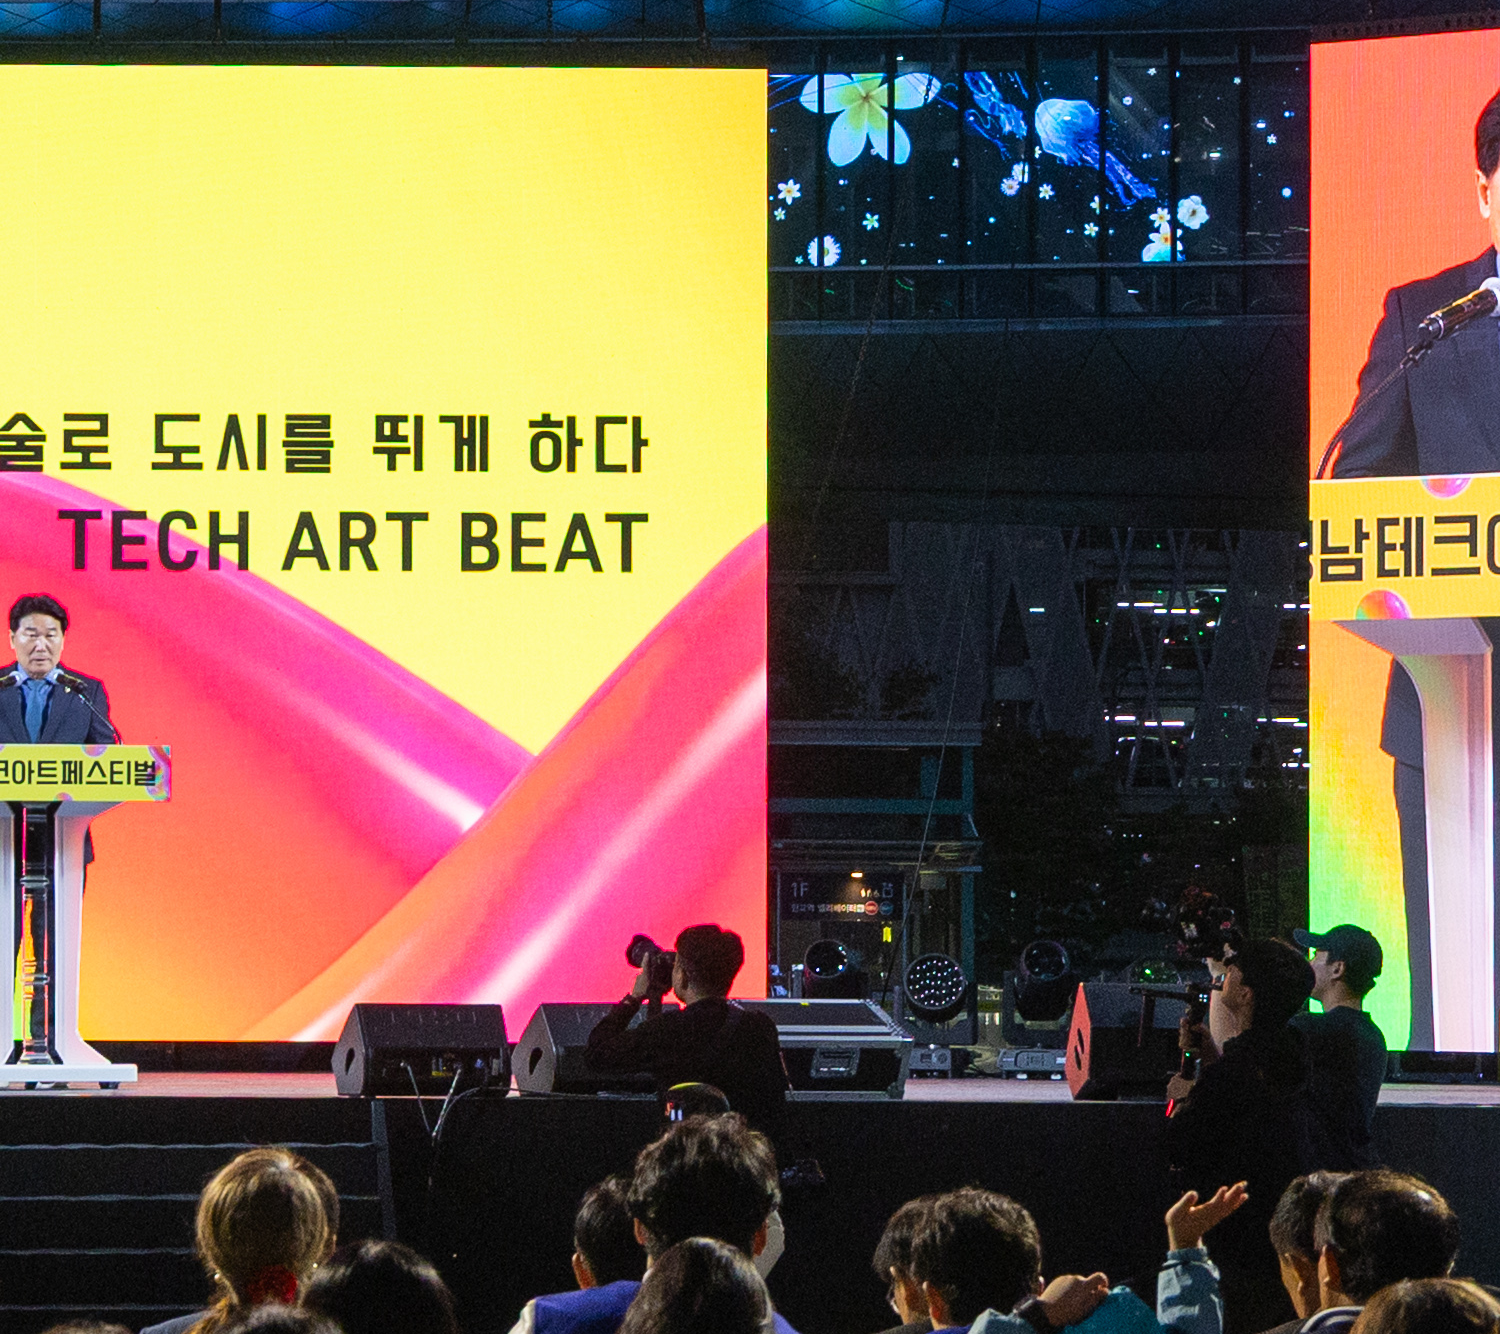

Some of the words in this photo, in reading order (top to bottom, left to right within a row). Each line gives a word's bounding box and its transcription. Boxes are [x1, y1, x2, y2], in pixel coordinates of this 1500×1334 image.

[150, 411, 335, 474] 도시를
[372, 411, 491, 474] 뛰게
[528, 411, 648, 474] 하다
[58, 509, 250, 572] TECH
[281, 509, 430, 572] ART
[460, 509, 649, 572] BEAT
[791, 882, 809, 898] 1F
